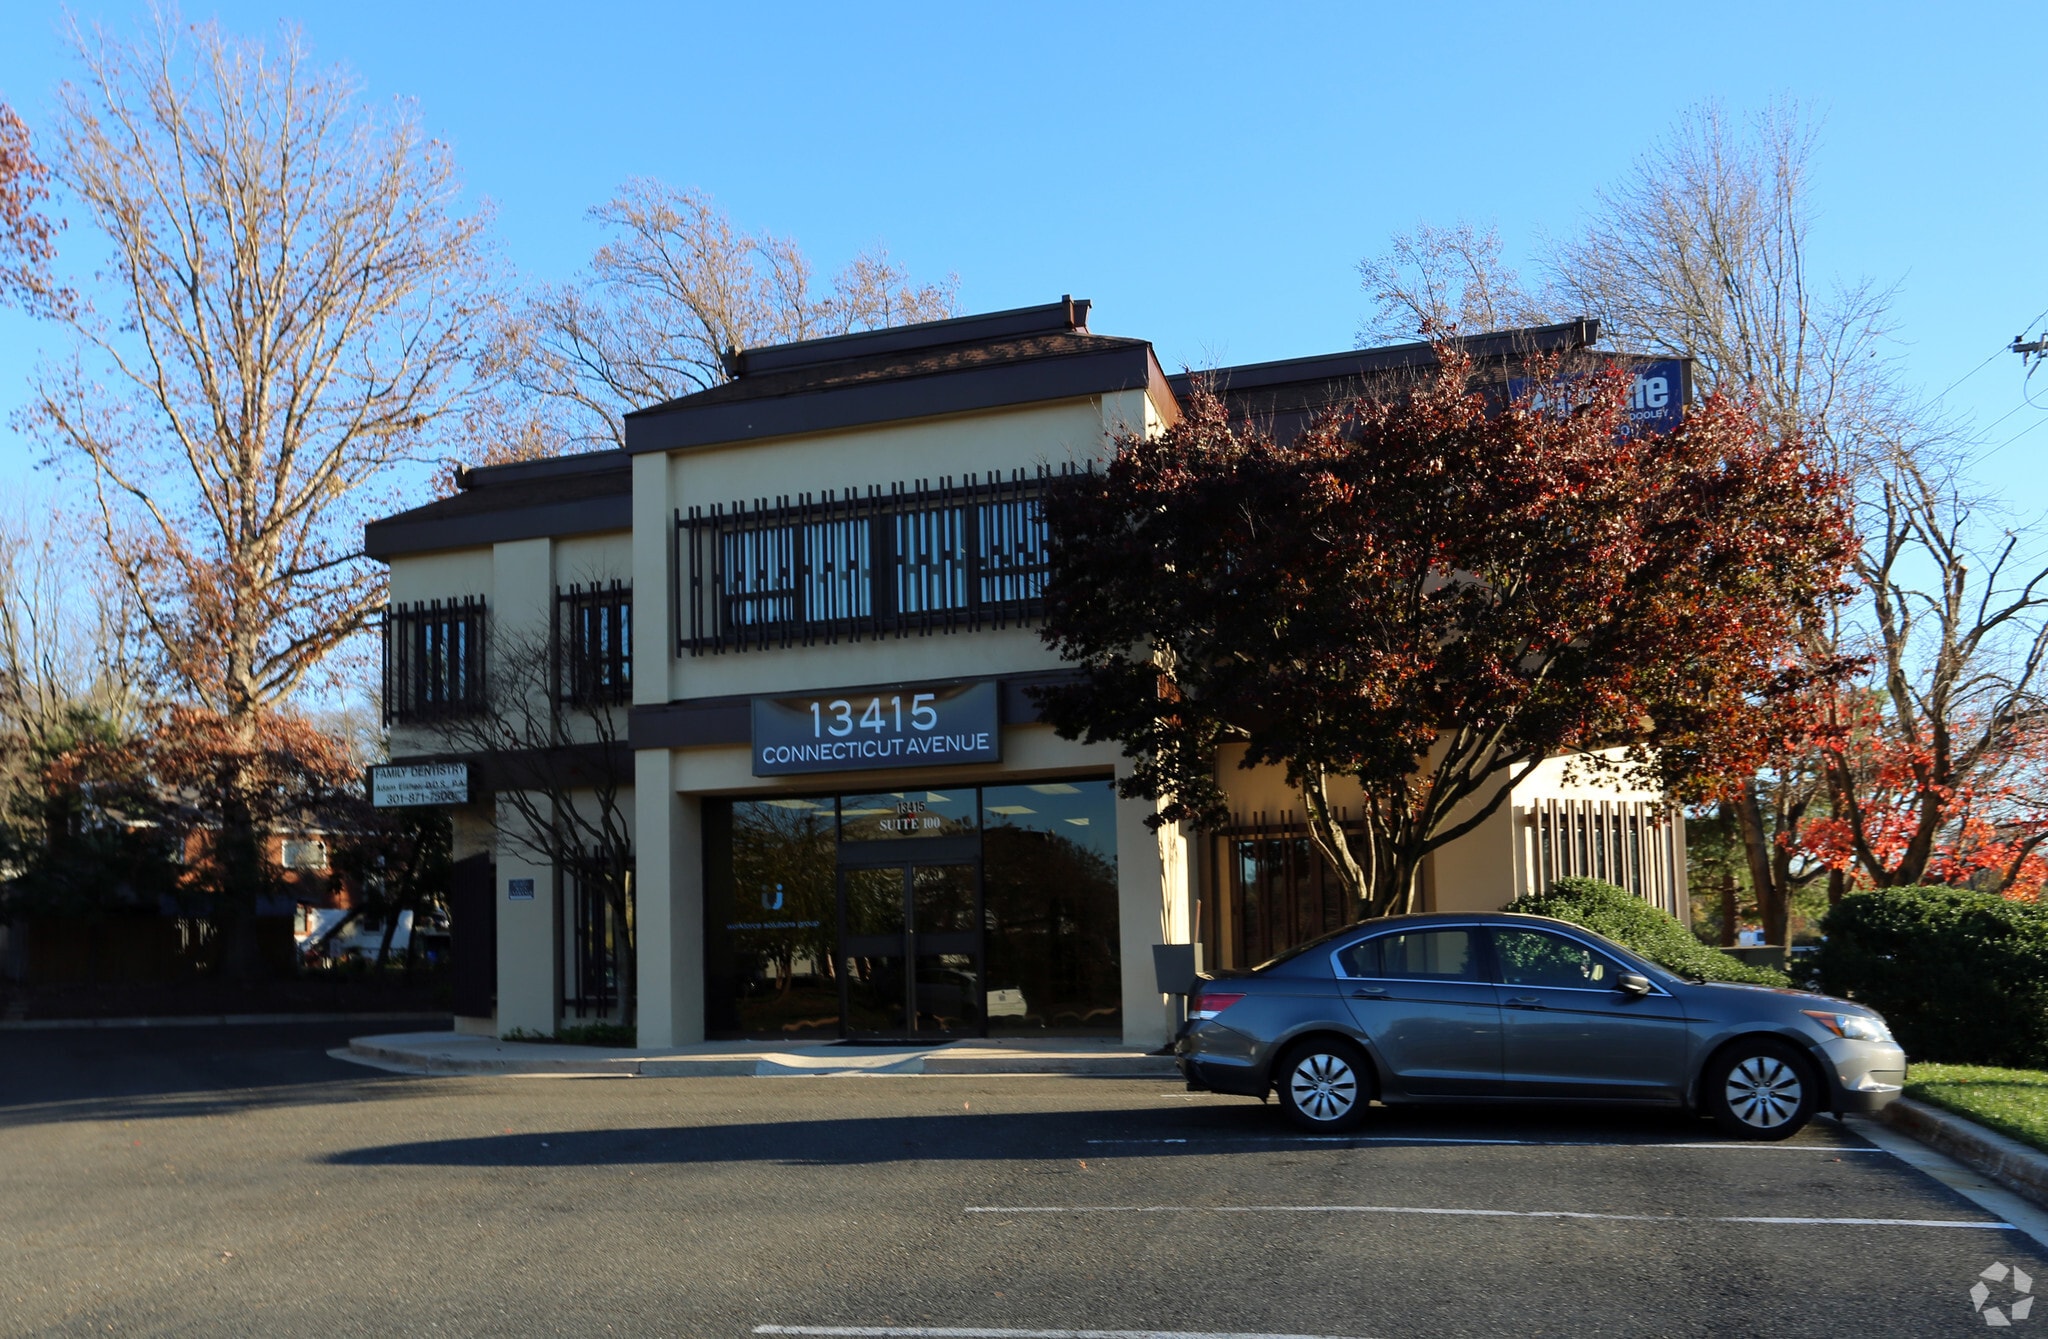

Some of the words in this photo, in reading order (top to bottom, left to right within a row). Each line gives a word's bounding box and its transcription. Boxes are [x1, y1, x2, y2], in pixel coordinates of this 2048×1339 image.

[810, 693, 937, 738] 13415
[762, 739, 904, 764] CONNECTICUT
[906, 733, 989, 755] AVENUE
[375, 766, 406, 779] FAMILY
[411, 762, 466, 777] DENTISTRY
[897, 801, 925, 814] 13415
[880, 818, 919, 831] SUITE
[924, 816, 940, 829] 100
